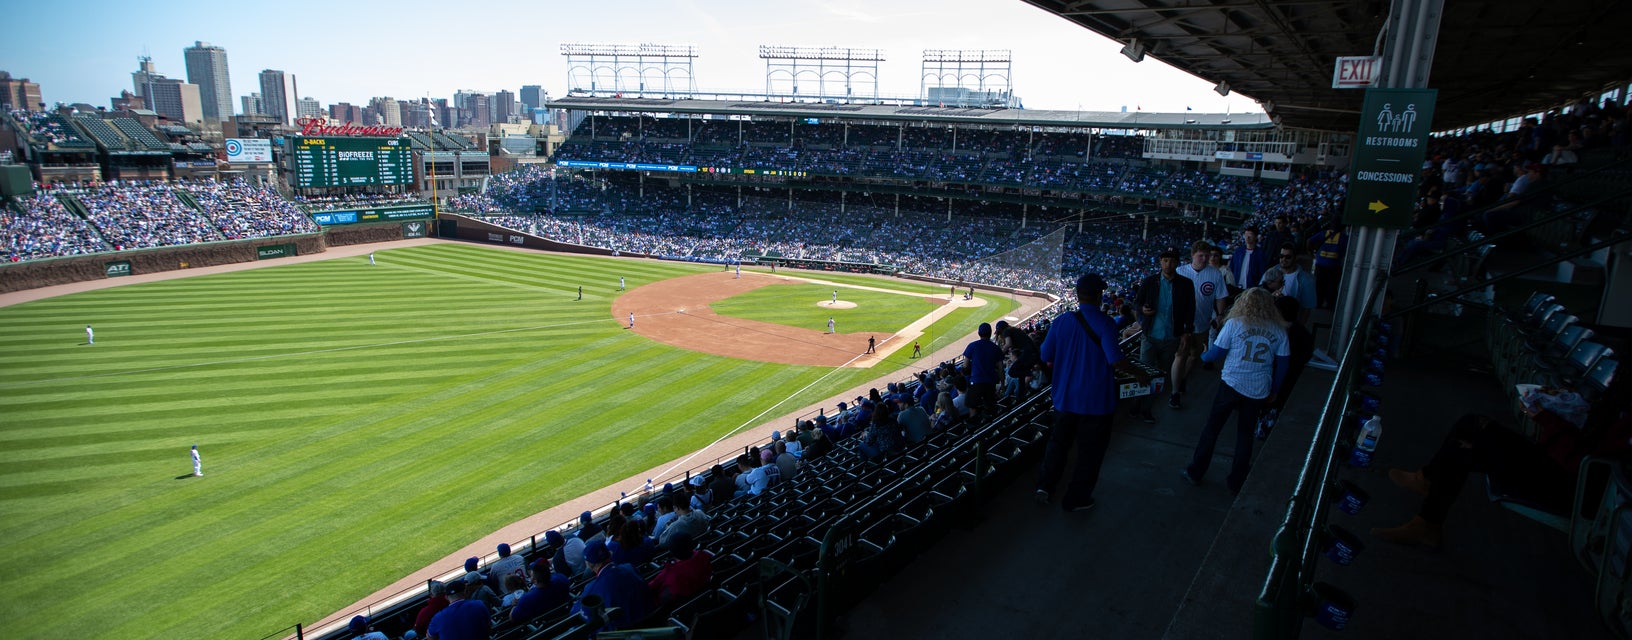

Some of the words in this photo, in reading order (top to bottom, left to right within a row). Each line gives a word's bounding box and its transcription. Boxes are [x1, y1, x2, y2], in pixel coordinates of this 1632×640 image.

[1339, 59, 1375, 81] EXIT
[297, 118, 402, 136] Budweiser
[1366, 136, 1419, 148] RESTROOMS
[1357, 170, 1414, 184] CONCESSIONS
[509, 235, 524, 244] PCM
[259, 248, 284, 256] SLOAN
[107, 264, 129, 272] ATI
[1241, 341, 1271, 363] 12
